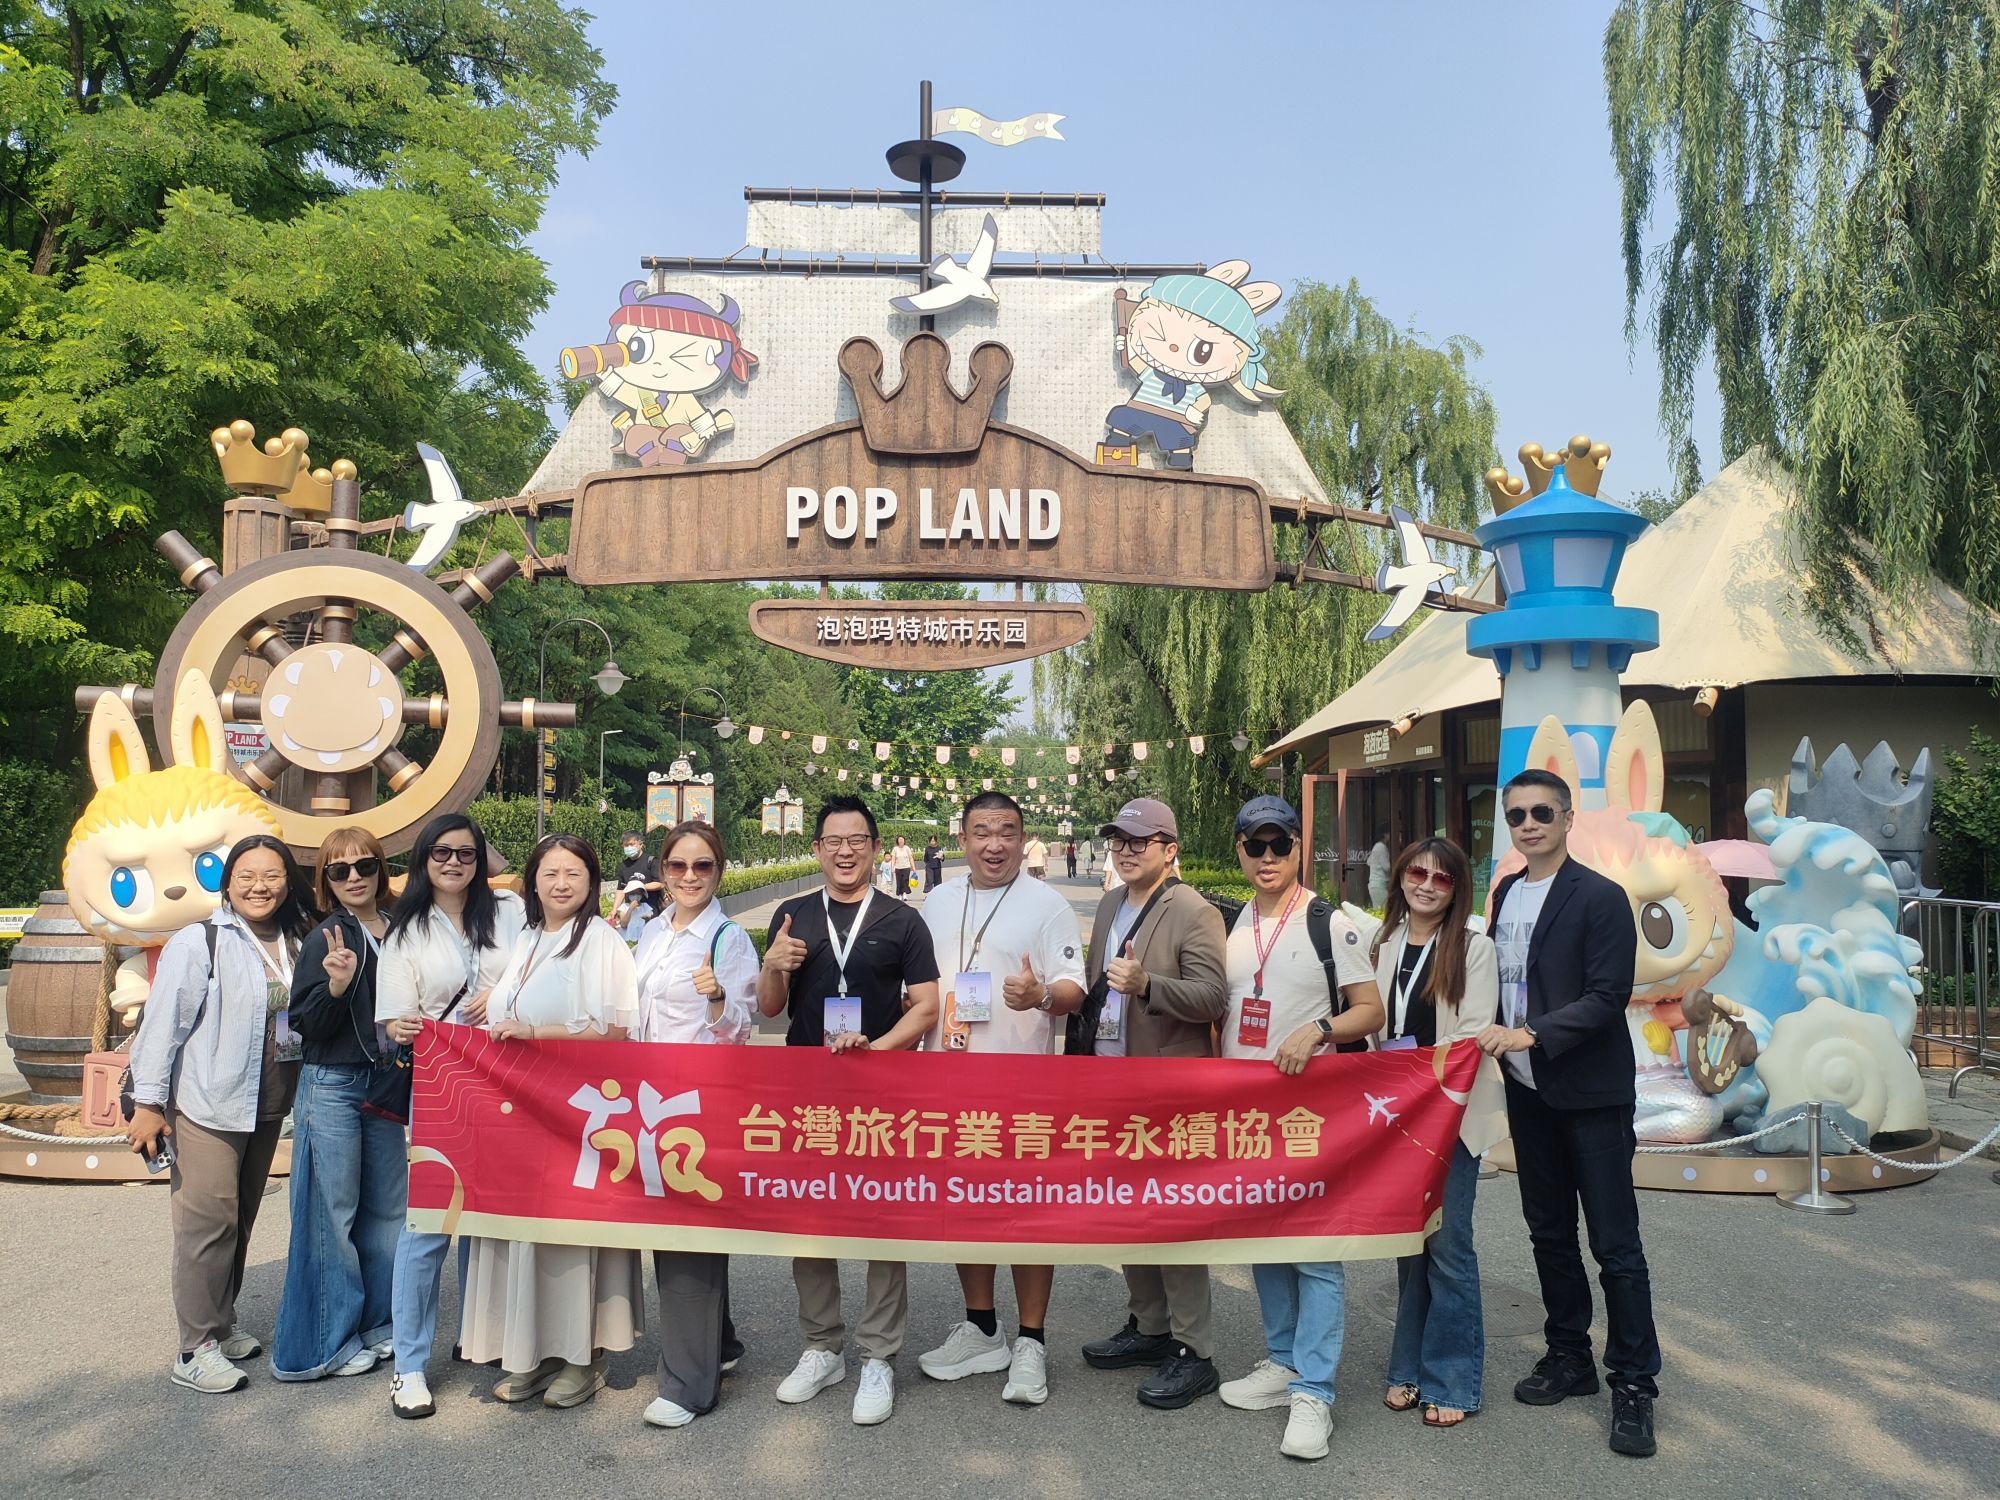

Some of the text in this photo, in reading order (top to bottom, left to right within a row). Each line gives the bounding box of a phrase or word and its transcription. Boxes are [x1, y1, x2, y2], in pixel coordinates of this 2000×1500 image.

[787, 486, 1061, 540] POP LAND
[816, 615, 1028, 644] 泡泡玛特城市乐园
[235, 734, 257, 745] LAND
[738, 1103, 1326, 1161] 台灣旅行業青年永續協會
[738, 1171, 1326, 1205] Travel Youth Sustainable Association
